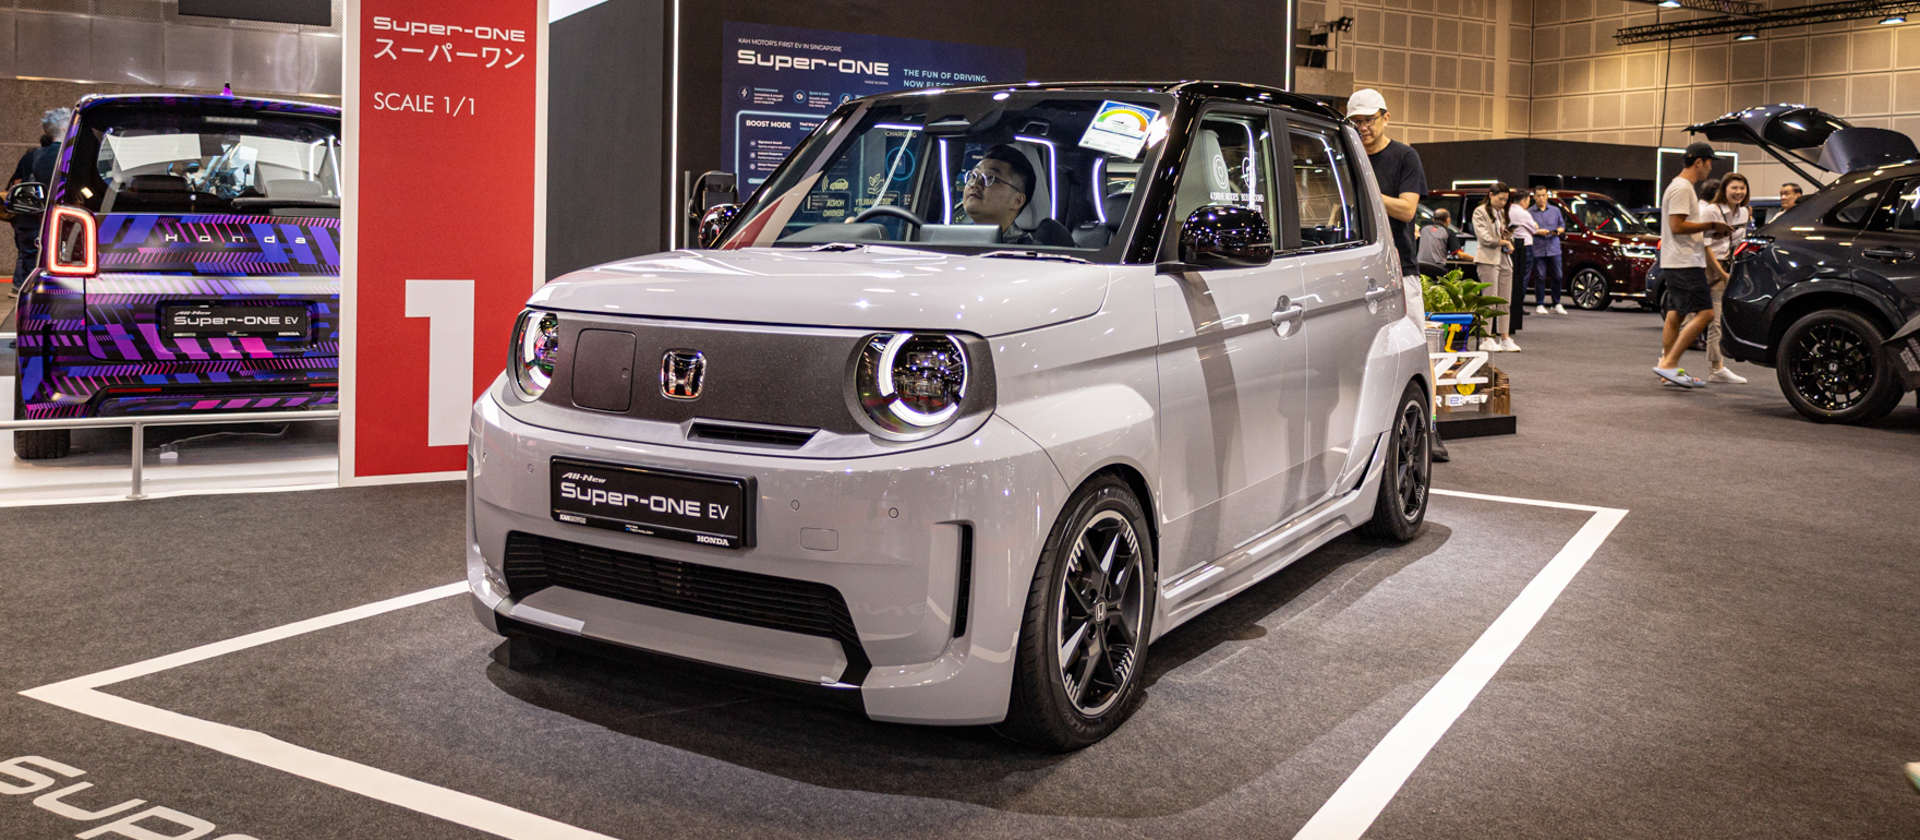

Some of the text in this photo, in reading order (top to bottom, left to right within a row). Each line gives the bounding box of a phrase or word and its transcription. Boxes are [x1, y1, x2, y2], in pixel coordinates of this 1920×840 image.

[373, 16, 525, 42] Super-ONE
[752, 39, 777, 47] MOTOR'S
[810, 44, 842, 53] SINGAPORE
[373, 38, 525, 69] スーパーワン
[737, 49, 889, 76] Super-ONE
[904, 69, 989, 83] THE FUN OF DRIVING.
[904, 80, 923, 88] NOW
[373, 91, 475, 117] SCALE 1/1
[771, 121, 791, 129] MODE
[885, 130, 917, 138] CHARGG
[174, 316, 299, 327] Super-ONE EV
[405, 279, 475, 447] 1
[1429, 351, 1488, 385] ZZ
[562, 471, 606, 484] All-New
[561, 482, 730, 520] Super-ONE EV
[696, 535, 730, 546] HONDA
